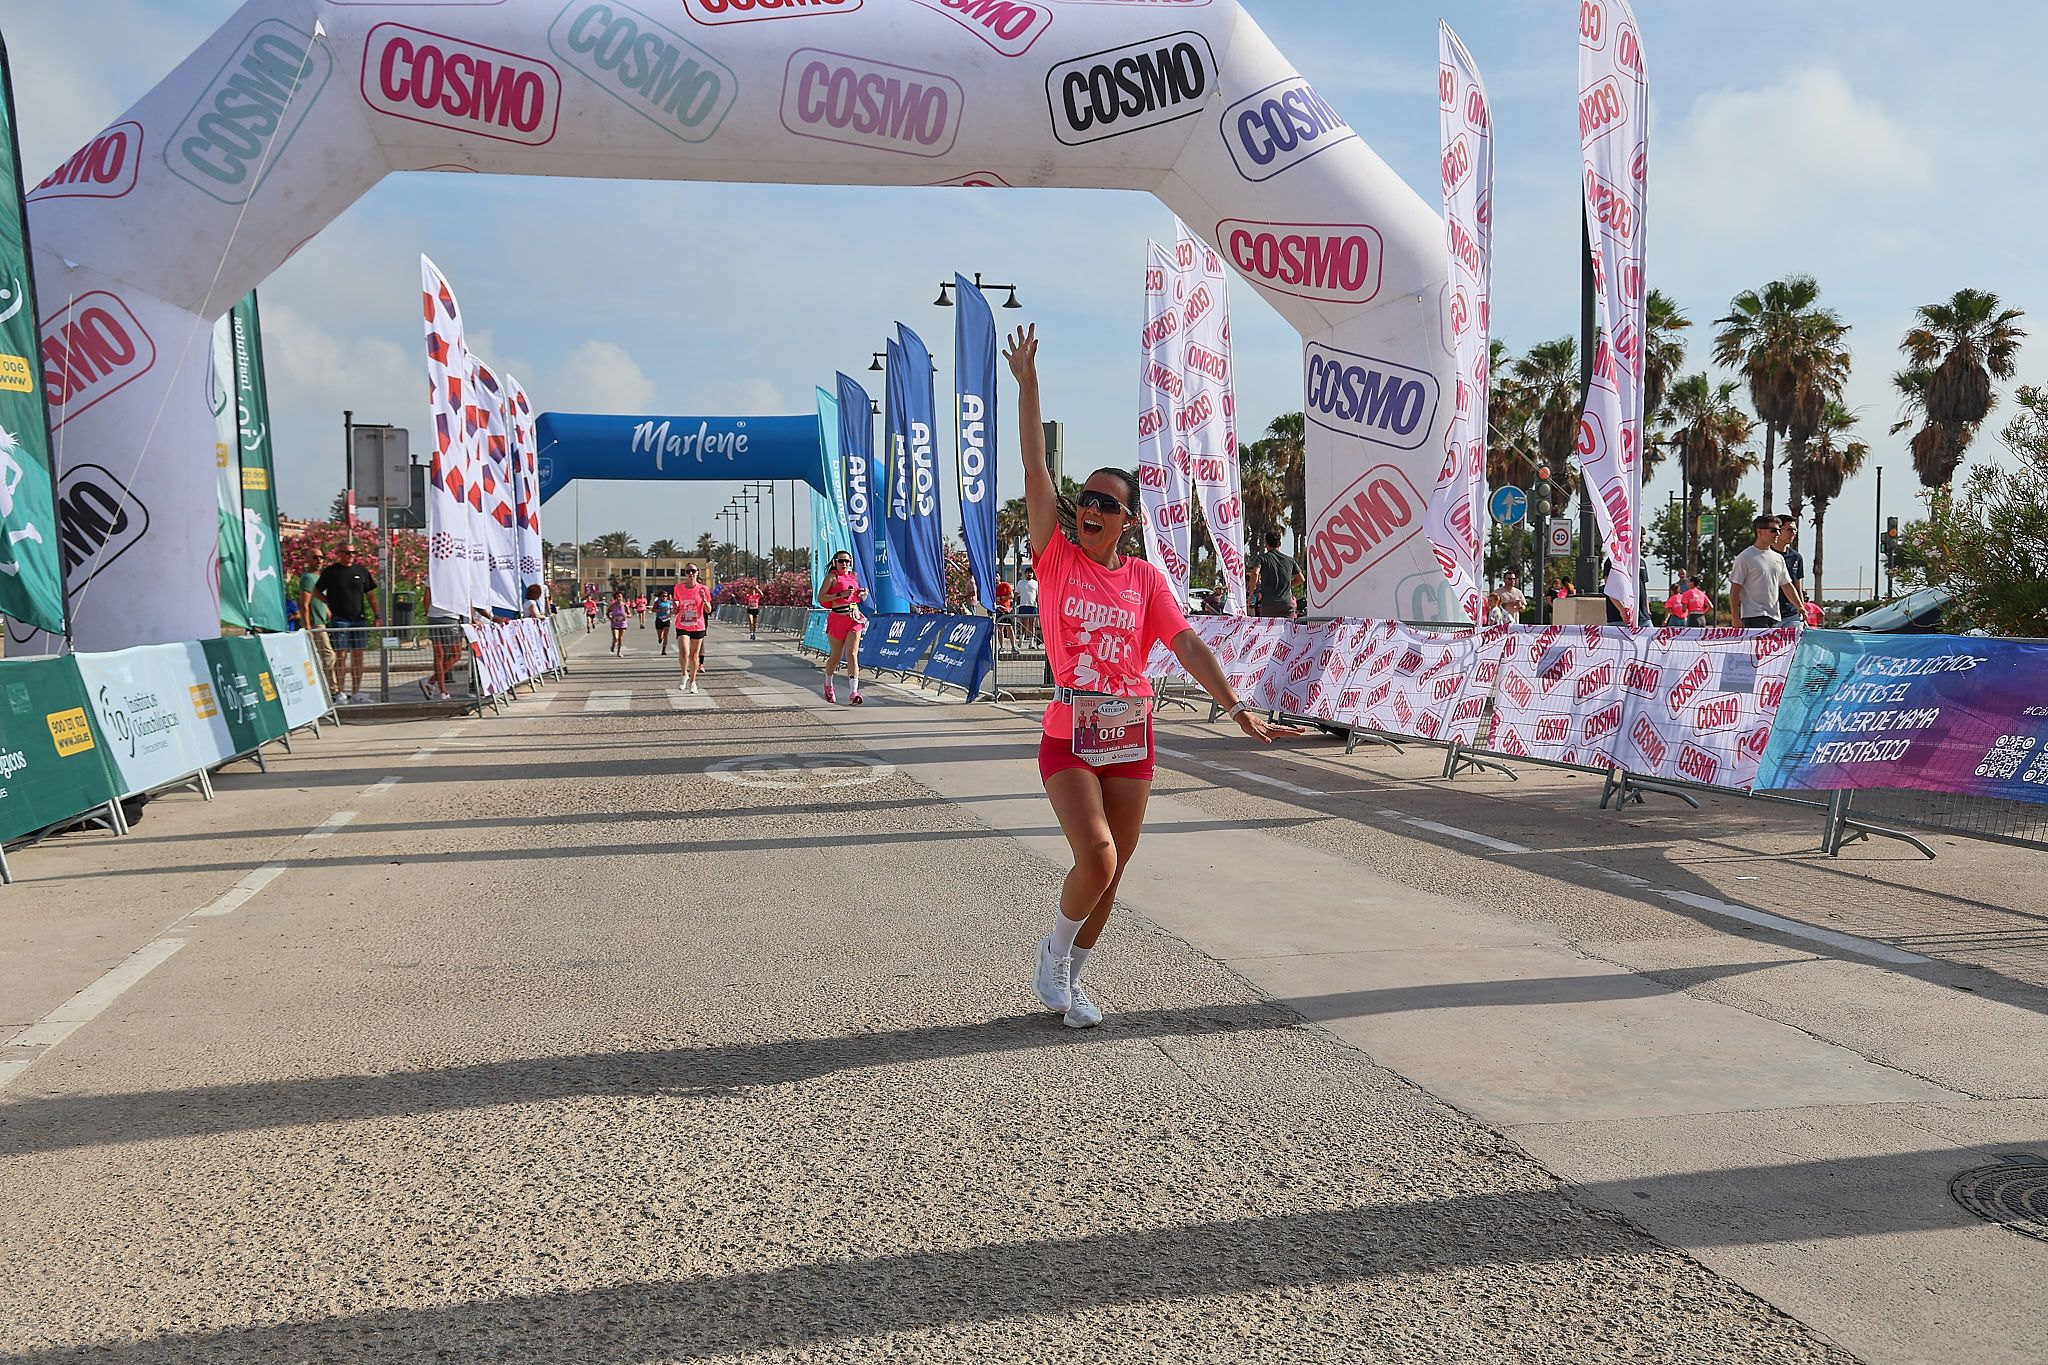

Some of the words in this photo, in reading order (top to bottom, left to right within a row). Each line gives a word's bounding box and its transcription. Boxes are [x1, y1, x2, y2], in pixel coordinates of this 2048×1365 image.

[568, 4, 720, 127] COSMO
[379, 37, 544, 133] COSMO
[1062, 42, 1205, 131] COSMO
[181, 34, 314, 185] COSMO
[797, 61, 948, 146] COSMO
[1230, 230, 1369, 289] COSMO
[1308, 354, 1425, 435] COSMO
[631, 421, 749, 470] Marlene
[1309, 479, 1412, 592] COSMO
[1555, 533, 1565, 541] 30
[1064, 597, 1136, 632] CARRERA
[949, 622, 977, 645] GOYA
[1291, 661, 1312, 682] COSMO
[1370, 650, 1395, 676] COSMO
[1419, 650, 1452, 686] COSMO
[1541, 649, 1574, 693] COSMO
[1577, 663, 1611, 699] COSMO
[1623, 663, 1659, 693] COSMO
[1340, 690, 1360, 708] COSMO
[1366, 681, 1391, 707] COSMO
[1434, 675, 1463, 700] COSMO
[1504, 671, 1532, 708] COSMO
[1669, 659, 1708, 712] COSMO
[1417, 712, 1441, 739] COSMO
[1452, 698, 1483, 720] COSMO
[1584, 704, 1620, 740] COSMO
[1697, 698, 1739, 730] COSMO
[1814, 706, 1876, 732] CÁNCER
[1868, 710, 1898, 731] DE
[1889, 707, 1940, 730] MAMA
[1099, 727, 1126, 740] 016
[1536, 718, 1570, 740] COSMO
[1633, 717, 1666, 768] COSMO
[1679, 746, 1718, 784] COSMO
[1809, 735, 1911, 764] METASTÁSICO
